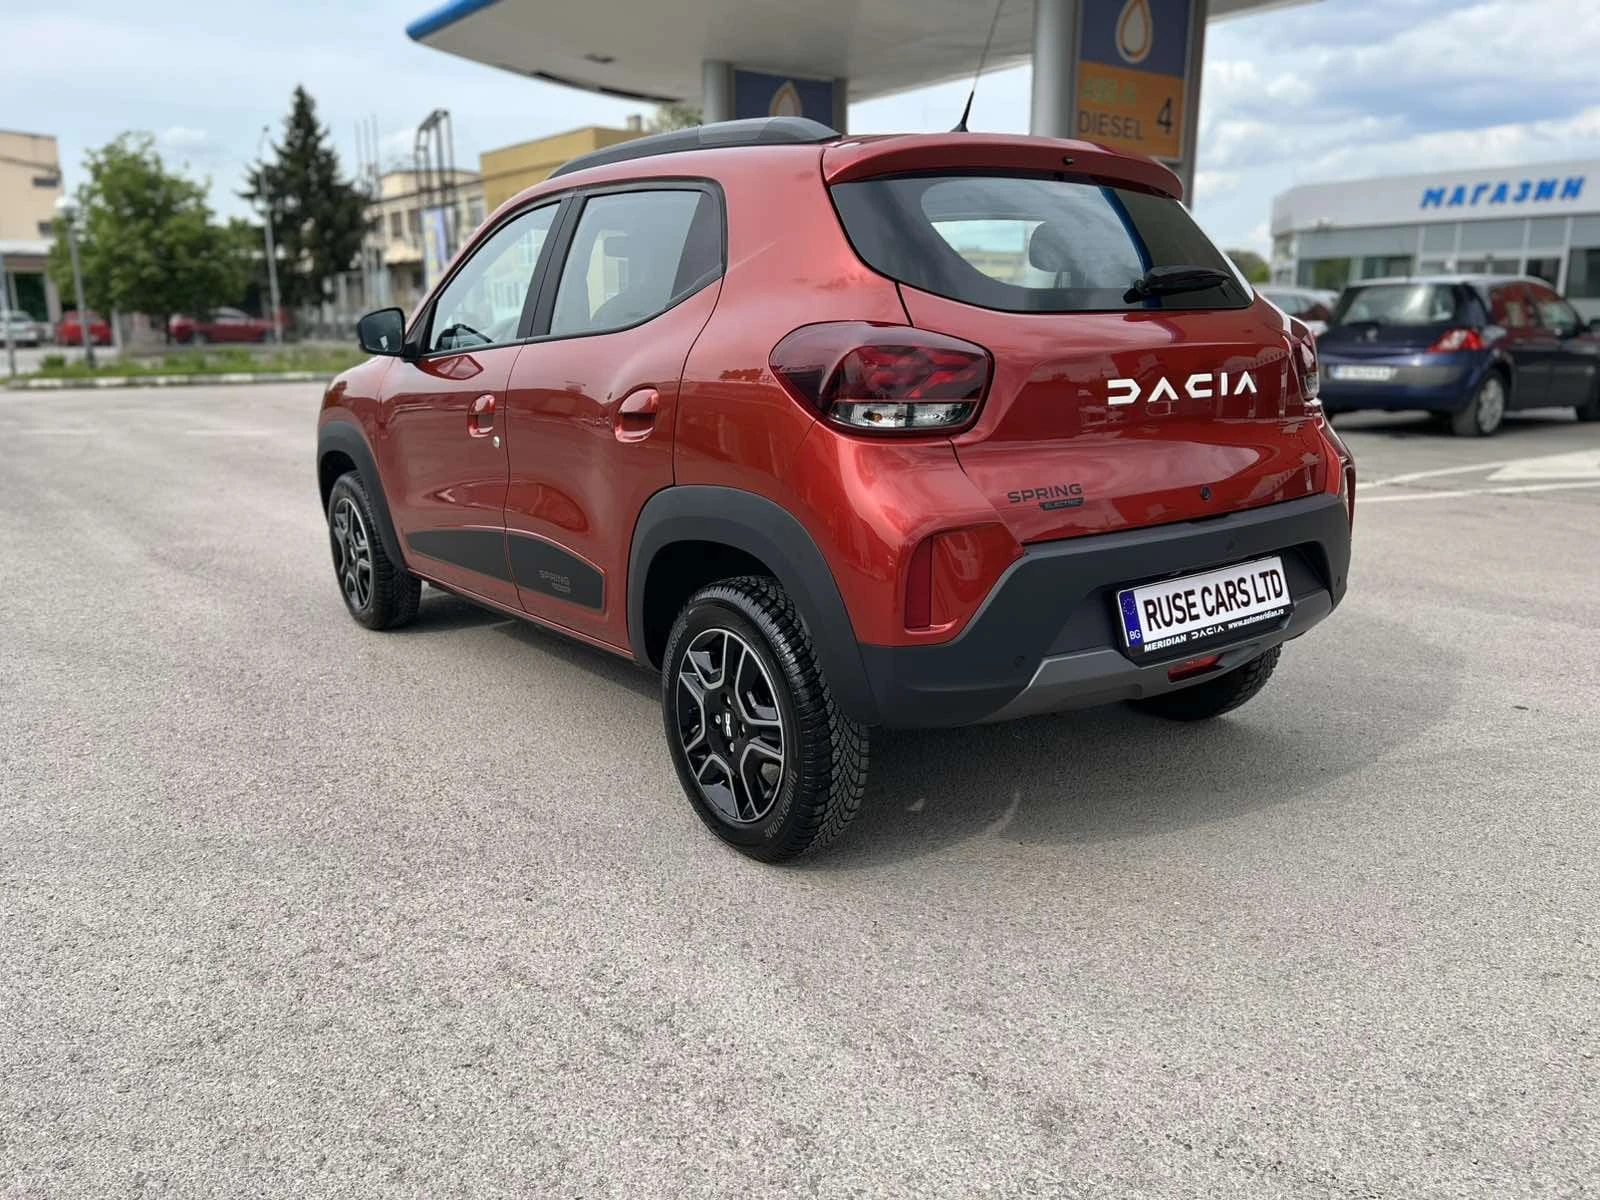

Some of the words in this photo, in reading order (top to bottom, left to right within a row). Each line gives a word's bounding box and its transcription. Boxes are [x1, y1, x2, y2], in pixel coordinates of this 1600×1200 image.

[1079, 111, 1144, 142] DIESEL
[1156, 96, 1173, 135] 4
[1419, 175, 1586, 209] МАГАЗИН
[1107, 370, 1257, 406] DACIA
[1007, 483, 1082, 503] SPRING
[1143, 589, 1200, 632] RUSE
[1201, 576, 1250, 617] CARS
[1250, 568, 1284, 604] LTD
[1129, 629, 1141, 640] BG
[1144, 633, 1187, 652] MERIDIAN
[1190, 624, 1225, 640] DACIA
